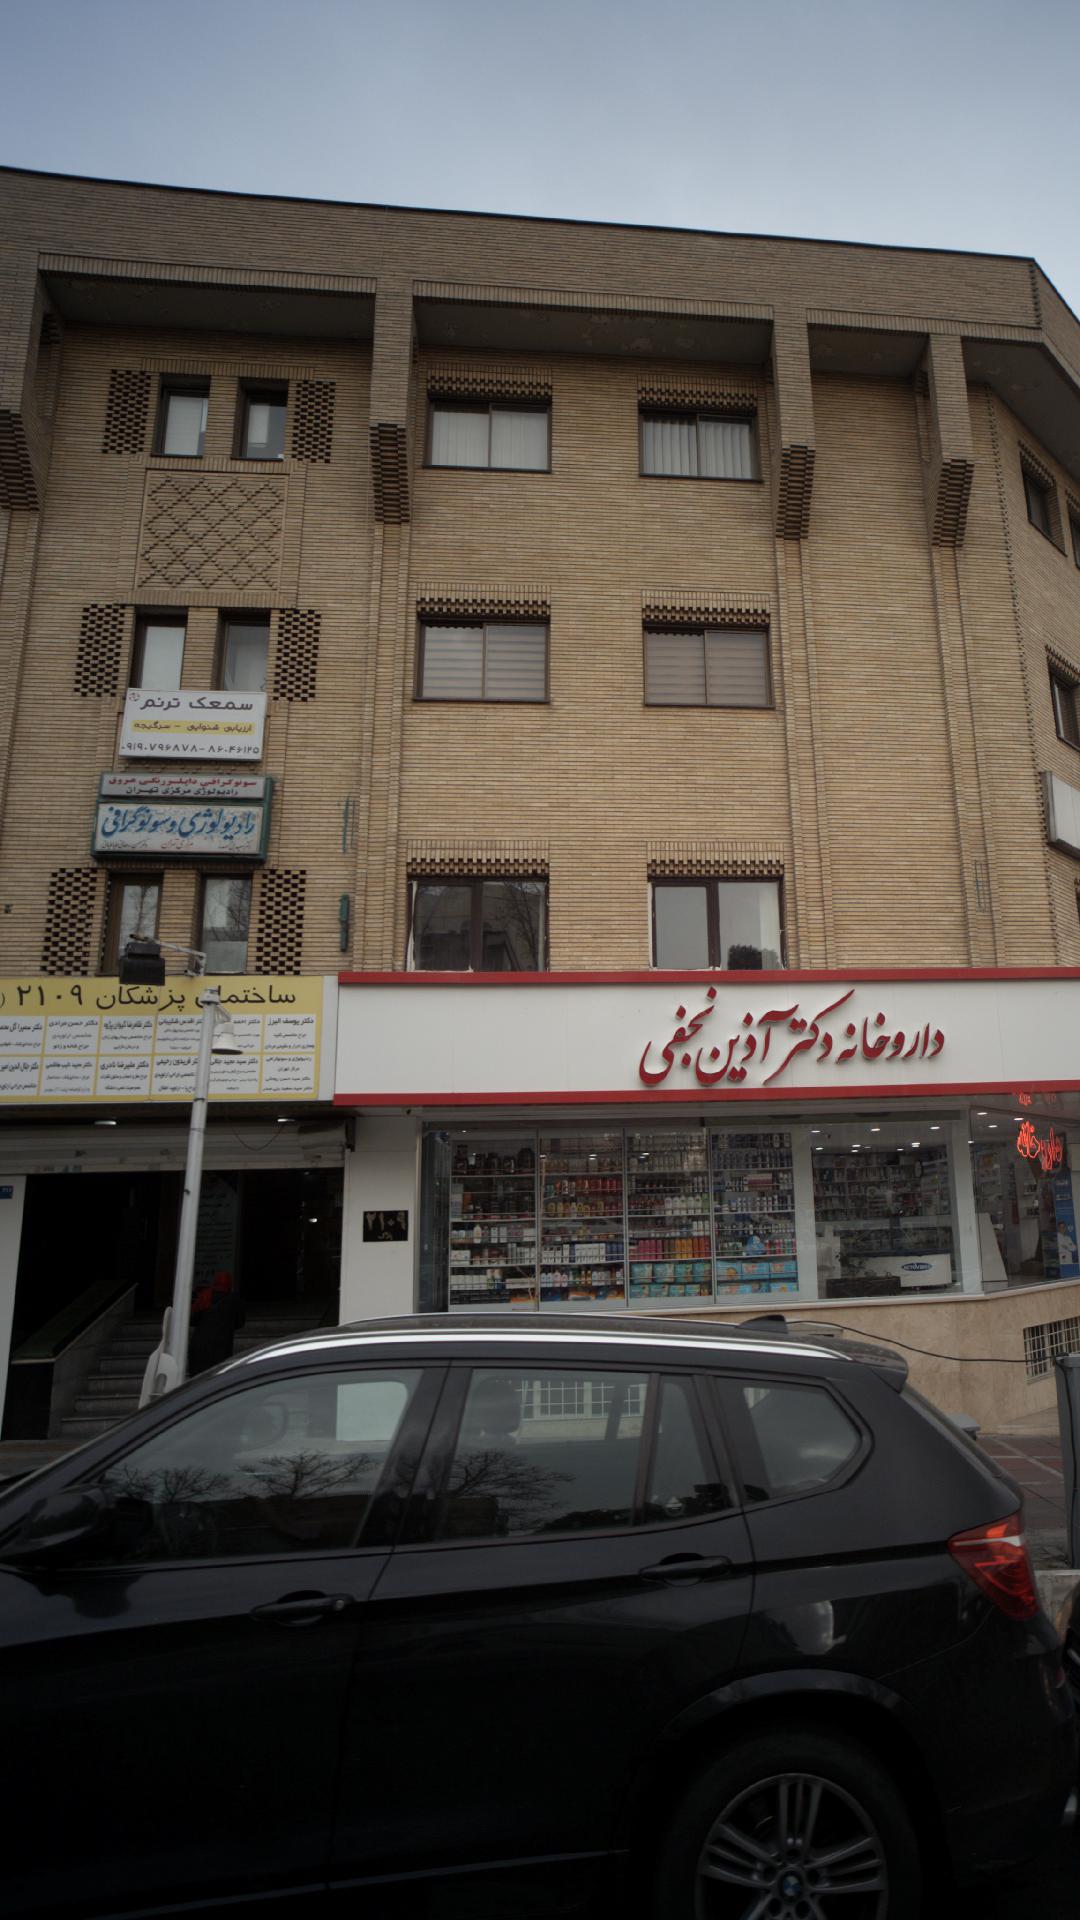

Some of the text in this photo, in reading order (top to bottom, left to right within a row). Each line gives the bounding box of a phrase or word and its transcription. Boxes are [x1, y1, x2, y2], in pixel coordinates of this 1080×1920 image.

[140, 697, 253, 711] سمعک ترنم
[134, 720, 171, 730] سرگیجه
[186, 723, 219, 732] شنوایی
[223, 724, 253, 733] ارزیابی
[101, 806, 171, 837] سونوگرافی
[179, 806, 255, 840] رادیولوژی
[17, 984, 83, 1006] ۲۱۰۹
[96, 985, 185, 1011] پزشکان
[84, 1019, 98, 1028] دکتر
[301, 1017, 314, 1025] دکتر
[639, 986, 945, 1086] داروخانه دکتر آذین نجفی
